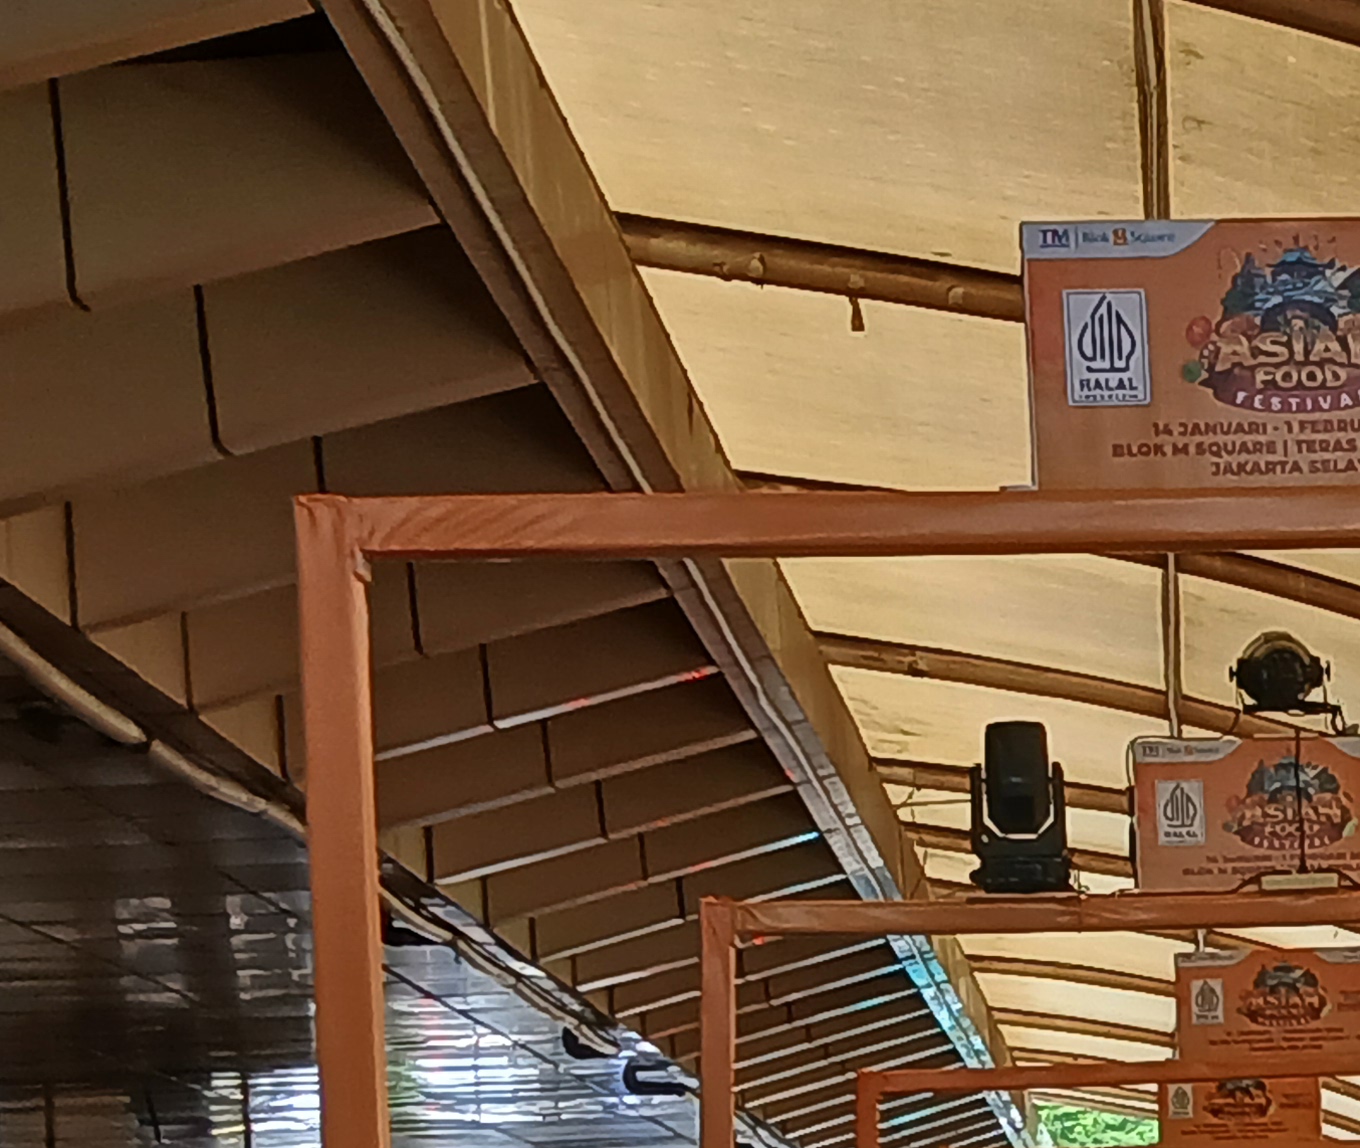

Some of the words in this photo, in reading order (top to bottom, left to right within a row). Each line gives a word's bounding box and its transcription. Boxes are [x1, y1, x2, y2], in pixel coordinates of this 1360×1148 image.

[1078, 377, 1139, 392] HALAL
[1255, 364, 1349, 390] FOOD
[1152, 421, 1174, 438] 14
[1177, 420, 1268, 438] JANUARI
[1111, 440, 1168, 459] BLOK
[1171, 441, 1190, 457] M
[1194, 438, 1278, 457] SQUARE
[1295, 438, 1358, 455] TERAS
[1210, 457, 1301, 478] JAKARTA
